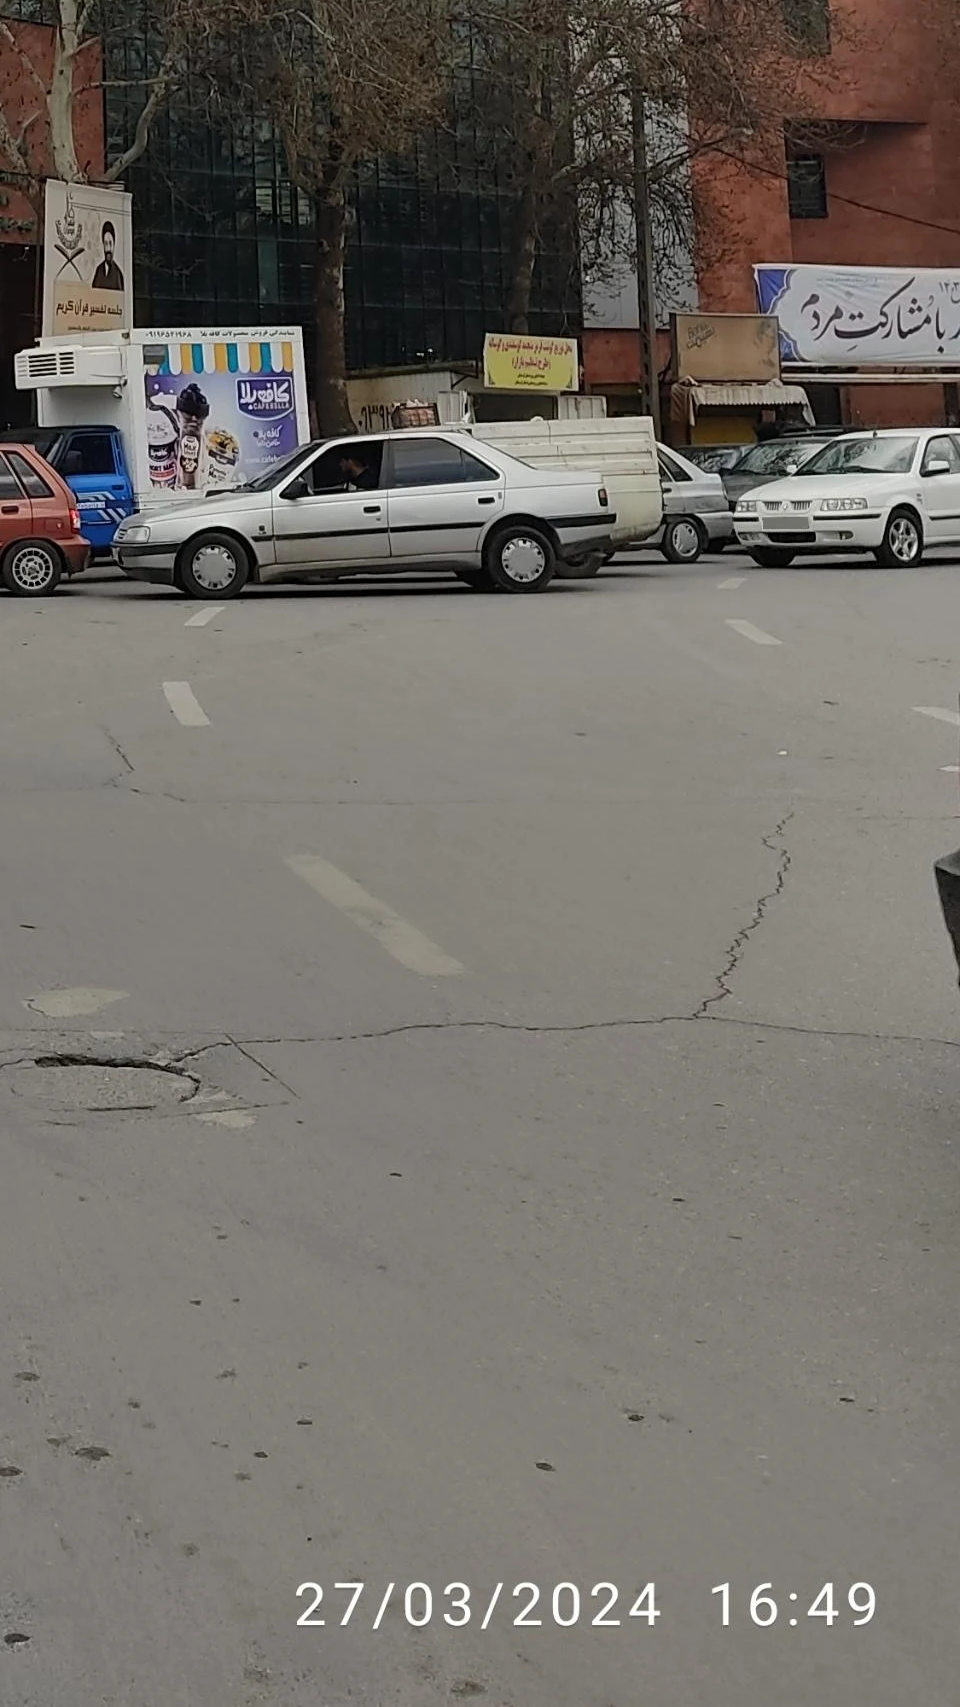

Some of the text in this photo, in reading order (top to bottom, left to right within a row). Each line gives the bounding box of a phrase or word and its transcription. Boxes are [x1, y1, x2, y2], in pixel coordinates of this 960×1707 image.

[56, 300, 74, 316] کریم
[800, 293, 844, 341] مردم
[935, 307, 946, 354] با
